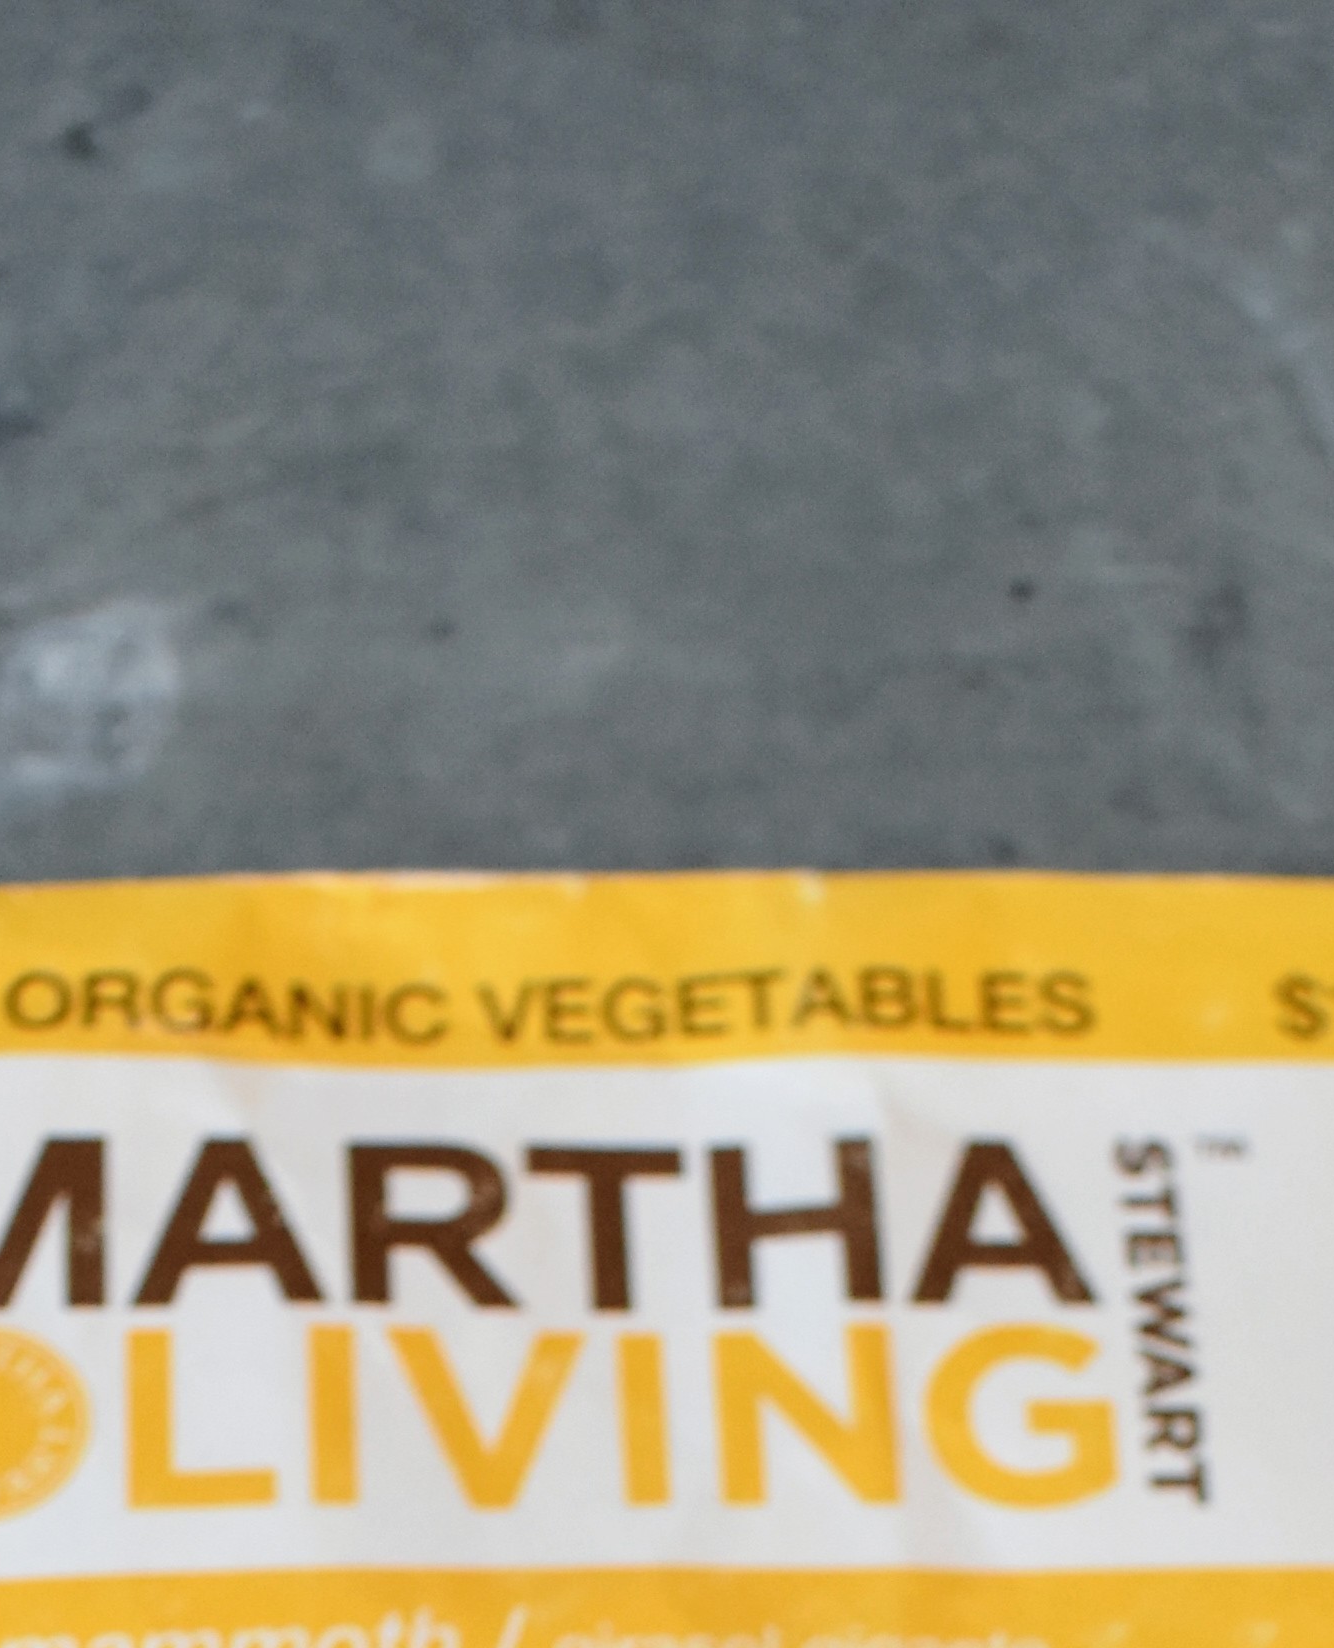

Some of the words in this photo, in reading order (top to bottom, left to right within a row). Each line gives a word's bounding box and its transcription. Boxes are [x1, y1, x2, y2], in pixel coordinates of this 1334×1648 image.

[3, 967, 449, 1046] ORGANIC
[473, 966, 1097, 1044] VEGETABLES
[1113, 1134, 1209, 1506] STEWART
[123, 1322, 1123, 1510] LIVING
